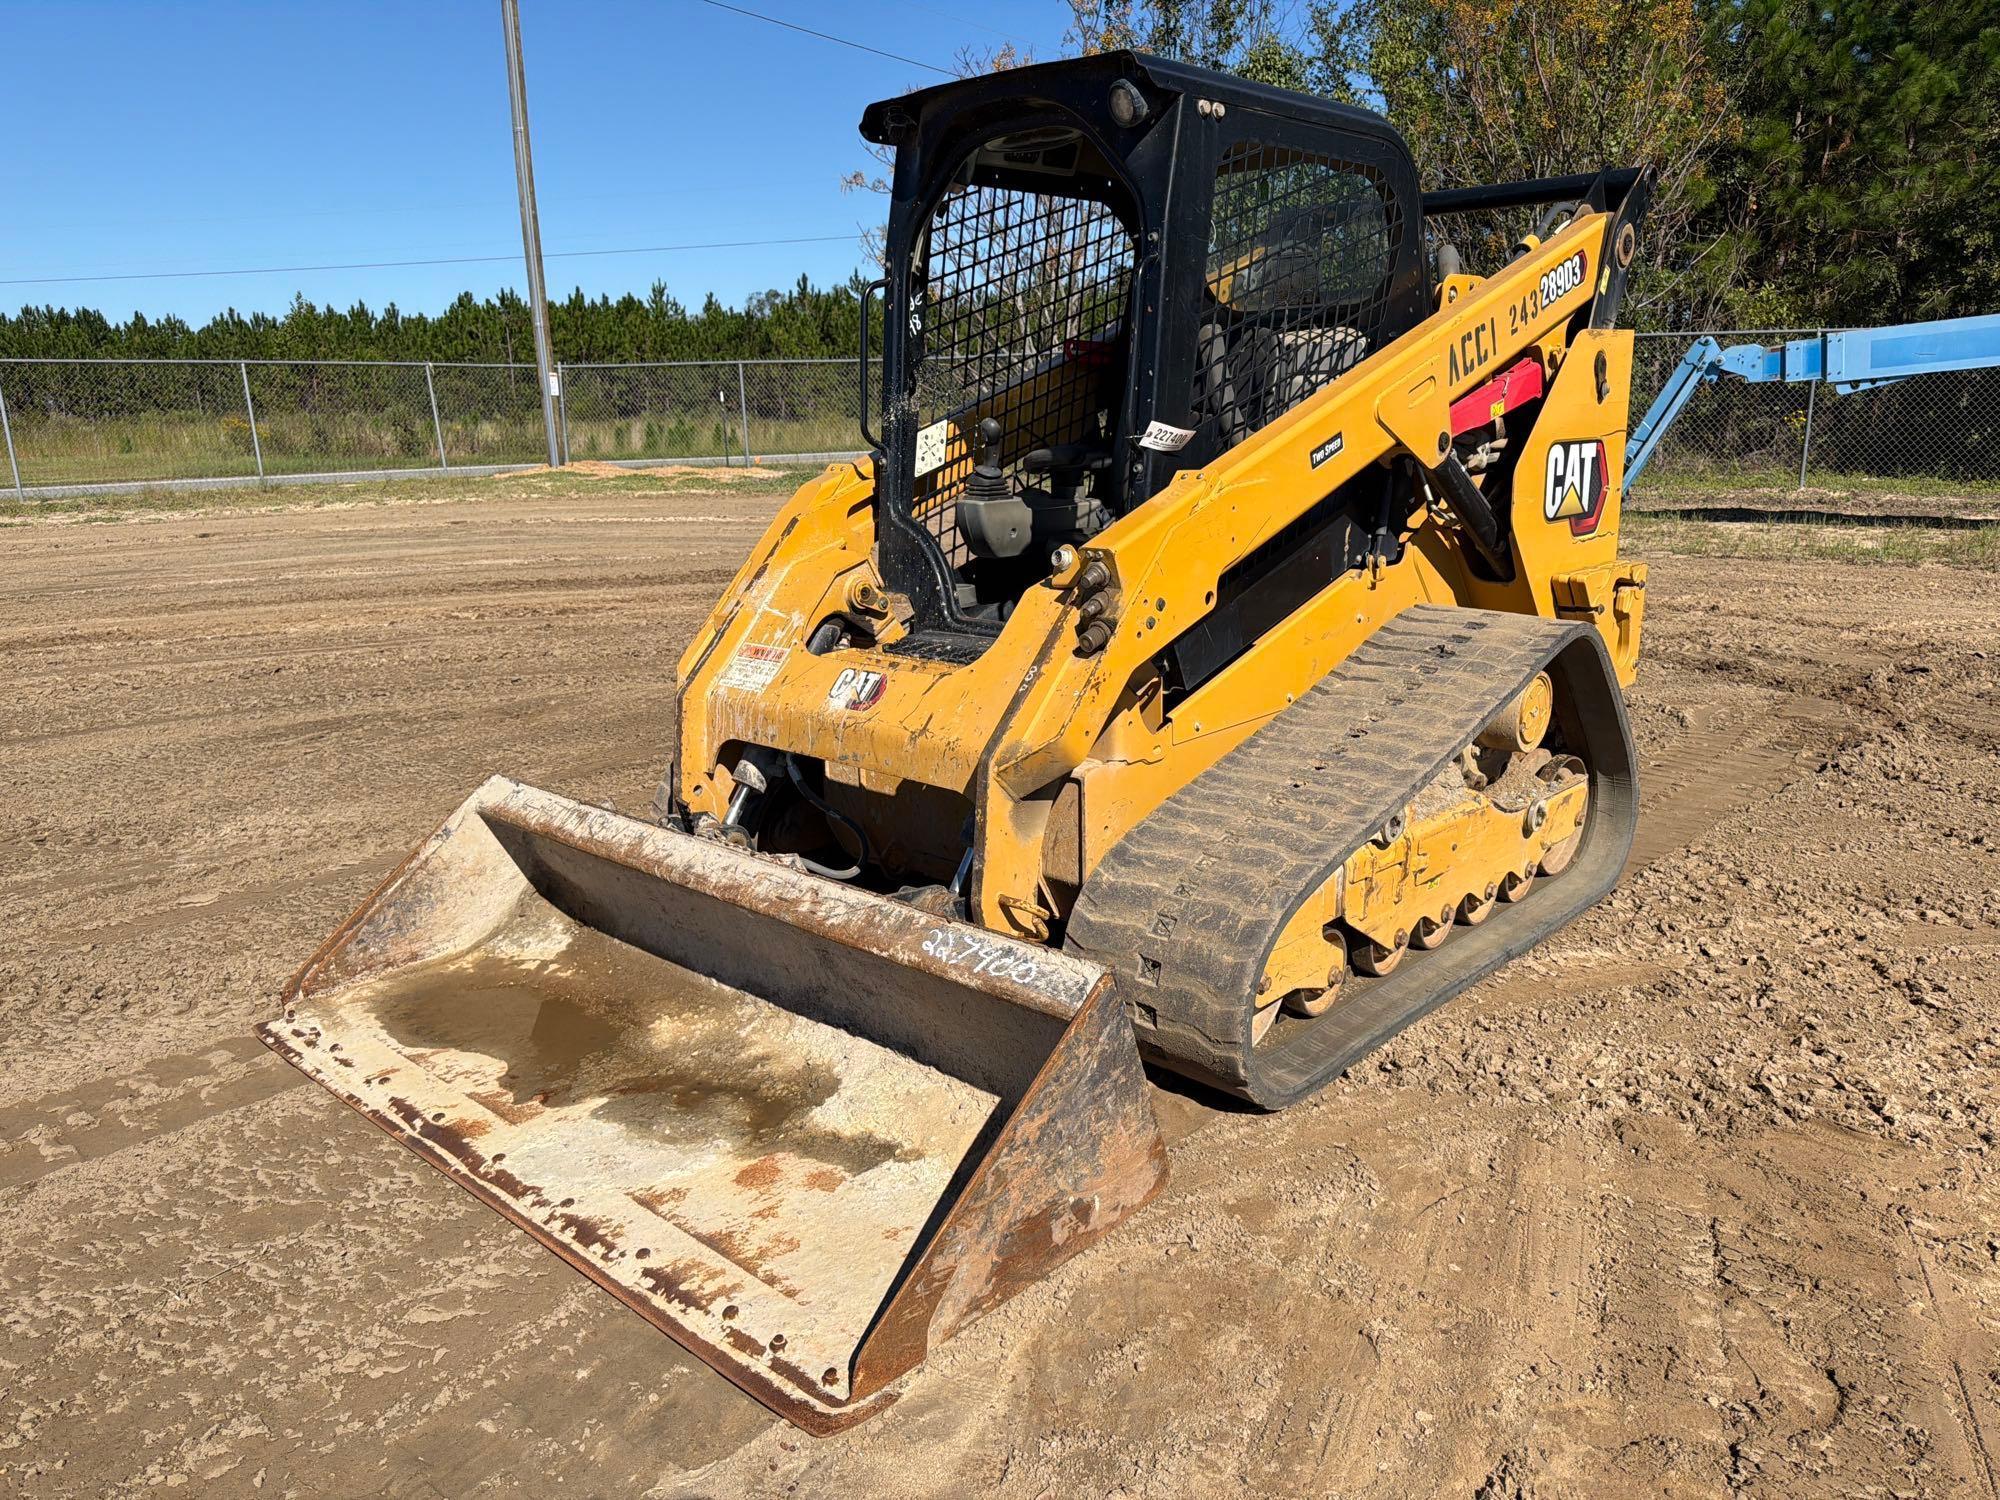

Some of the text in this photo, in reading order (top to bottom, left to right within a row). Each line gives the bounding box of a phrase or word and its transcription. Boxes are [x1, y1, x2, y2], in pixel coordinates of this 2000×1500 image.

[1540, 254, 1581, 309] 289D3
[1509, 289, 1539, 336] 243
[1153, 428, 1188, 444] 227400
[1325, 438, 1341, 456] SPEED
[1545, 442, 1597, 519] CAT
[829, 668, 882, 703] CAT
[921, 929, 1037, 984] 227400
